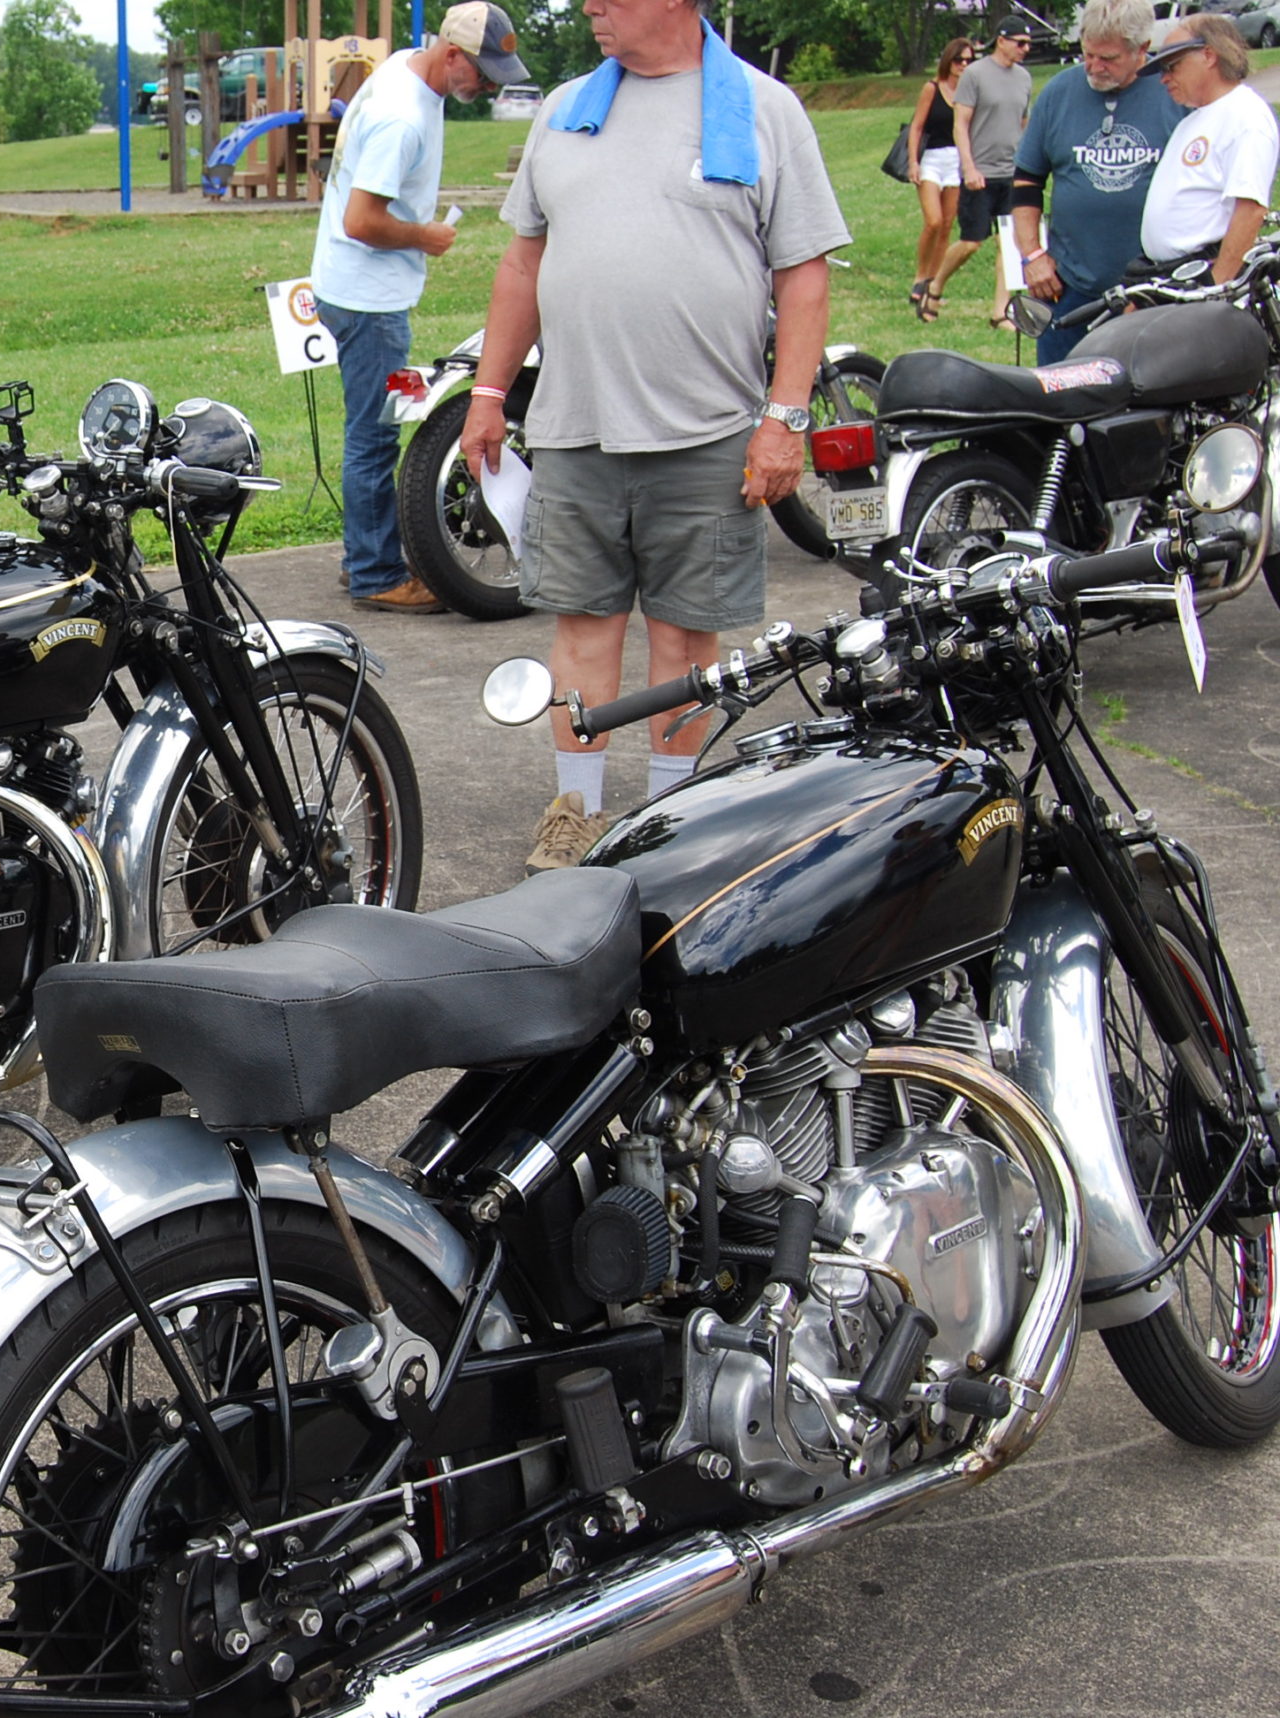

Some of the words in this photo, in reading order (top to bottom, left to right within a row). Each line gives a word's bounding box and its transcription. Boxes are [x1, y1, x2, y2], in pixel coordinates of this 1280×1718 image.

[1072, 146, 1160, 165] TRIUMPH
[304, 334, 325, 363] C
[860, 502, 882, 521] 585
[43, 623, 98, 646] VINCENT
[969, 806, 1017, 842] VINCENT
[937, 1221, 983, 1251] VINCENT
